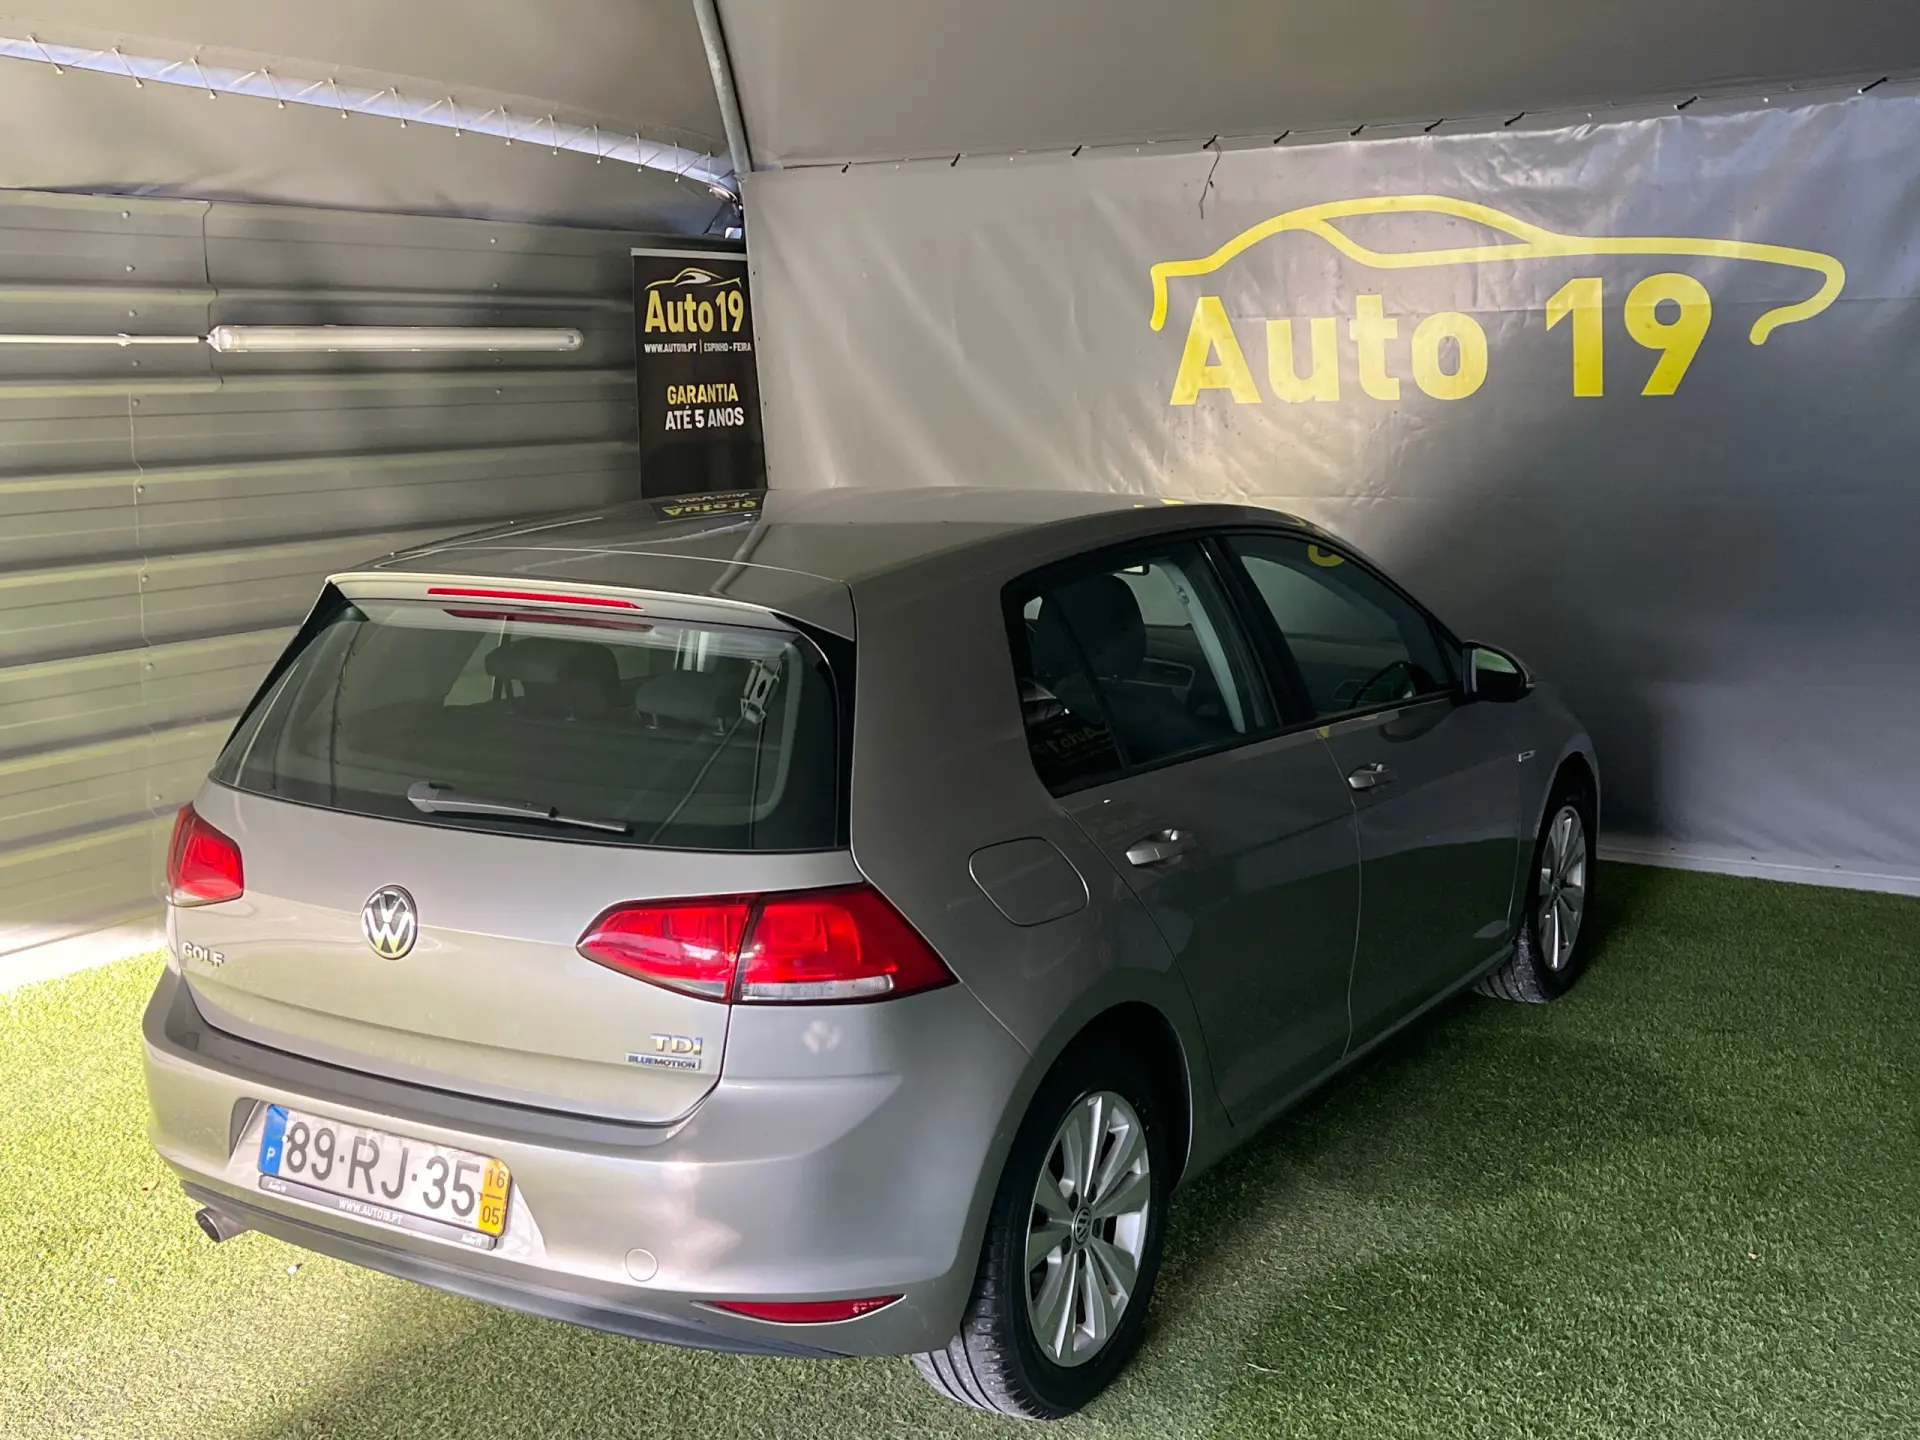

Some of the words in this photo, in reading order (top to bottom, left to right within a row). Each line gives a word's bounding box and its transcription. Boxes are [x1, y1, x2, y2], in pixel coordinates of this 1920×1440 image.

[1170, 294, 1488, 406] Auto
[1546, 272, 1712, 397] 19
[667, 382, 739, 405] GARANTIA
[665, 405, 693, 431] ATÉ
[694, 409, 705, 428] 5
[707, 406, 745, 428] ANOS
[182, 941, 225, 967] GOLF
[650, 1033, 703, 1056] TDI
[627, 1055, 696, 1069] BLUEMOTION
[266, 1147, 276, 1161] P
[487, 1170, 505, 1189] 16
[482, 1205, 501, 1226] 05
